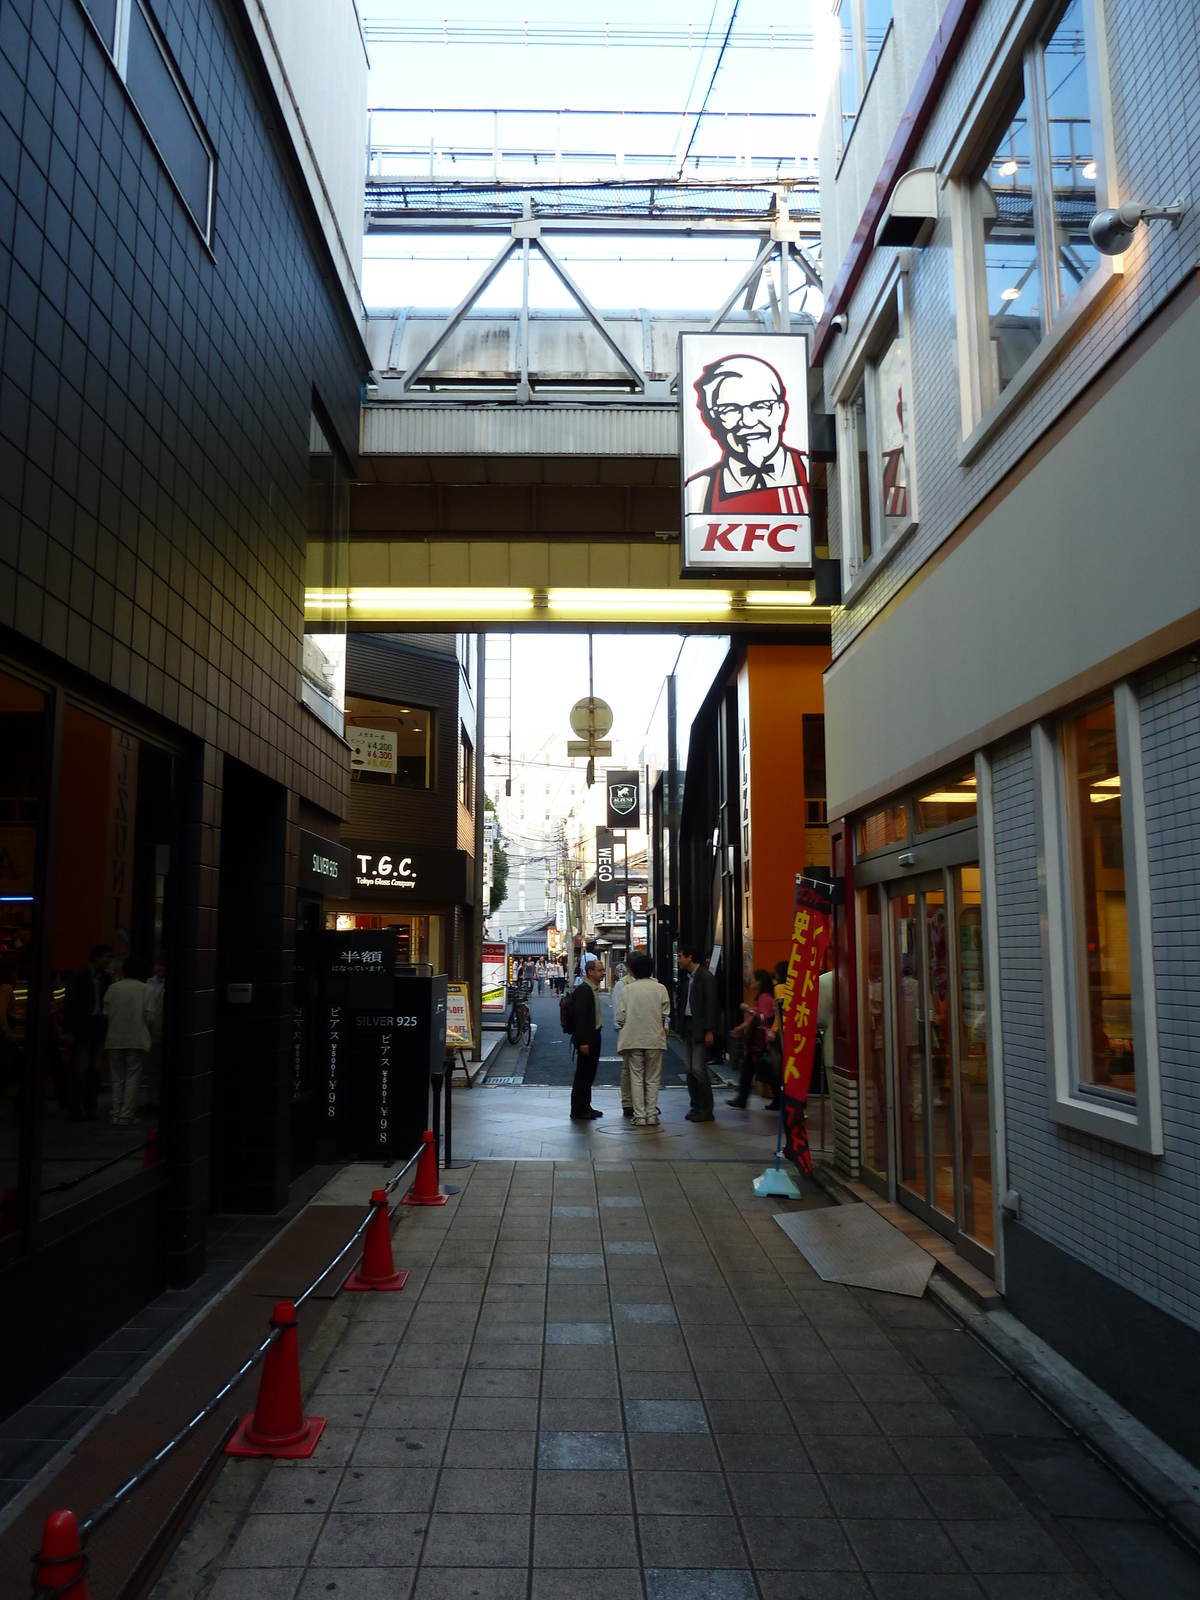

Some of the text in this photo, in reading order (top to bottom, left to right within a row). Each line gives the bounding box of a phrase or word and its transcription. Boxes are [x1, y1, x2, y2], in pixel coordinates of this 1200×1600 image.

[700, 523, 799, 552] KFC
[367, 742, 392, 751] ¥4,200
[367, 751, 392, 760] ¥6,300
[312, 854, 339, 877] SILVER 925
[356, 854, 417, 877] T.G.C.
[598, 847, 612, 881] WEGO
[355, 877, 374, 886] Tokyo
[391, 879, 415, 888] Company
[340, 950, 383, 963] 半額
[355, 1016, 418, 1027] SILVER 925
